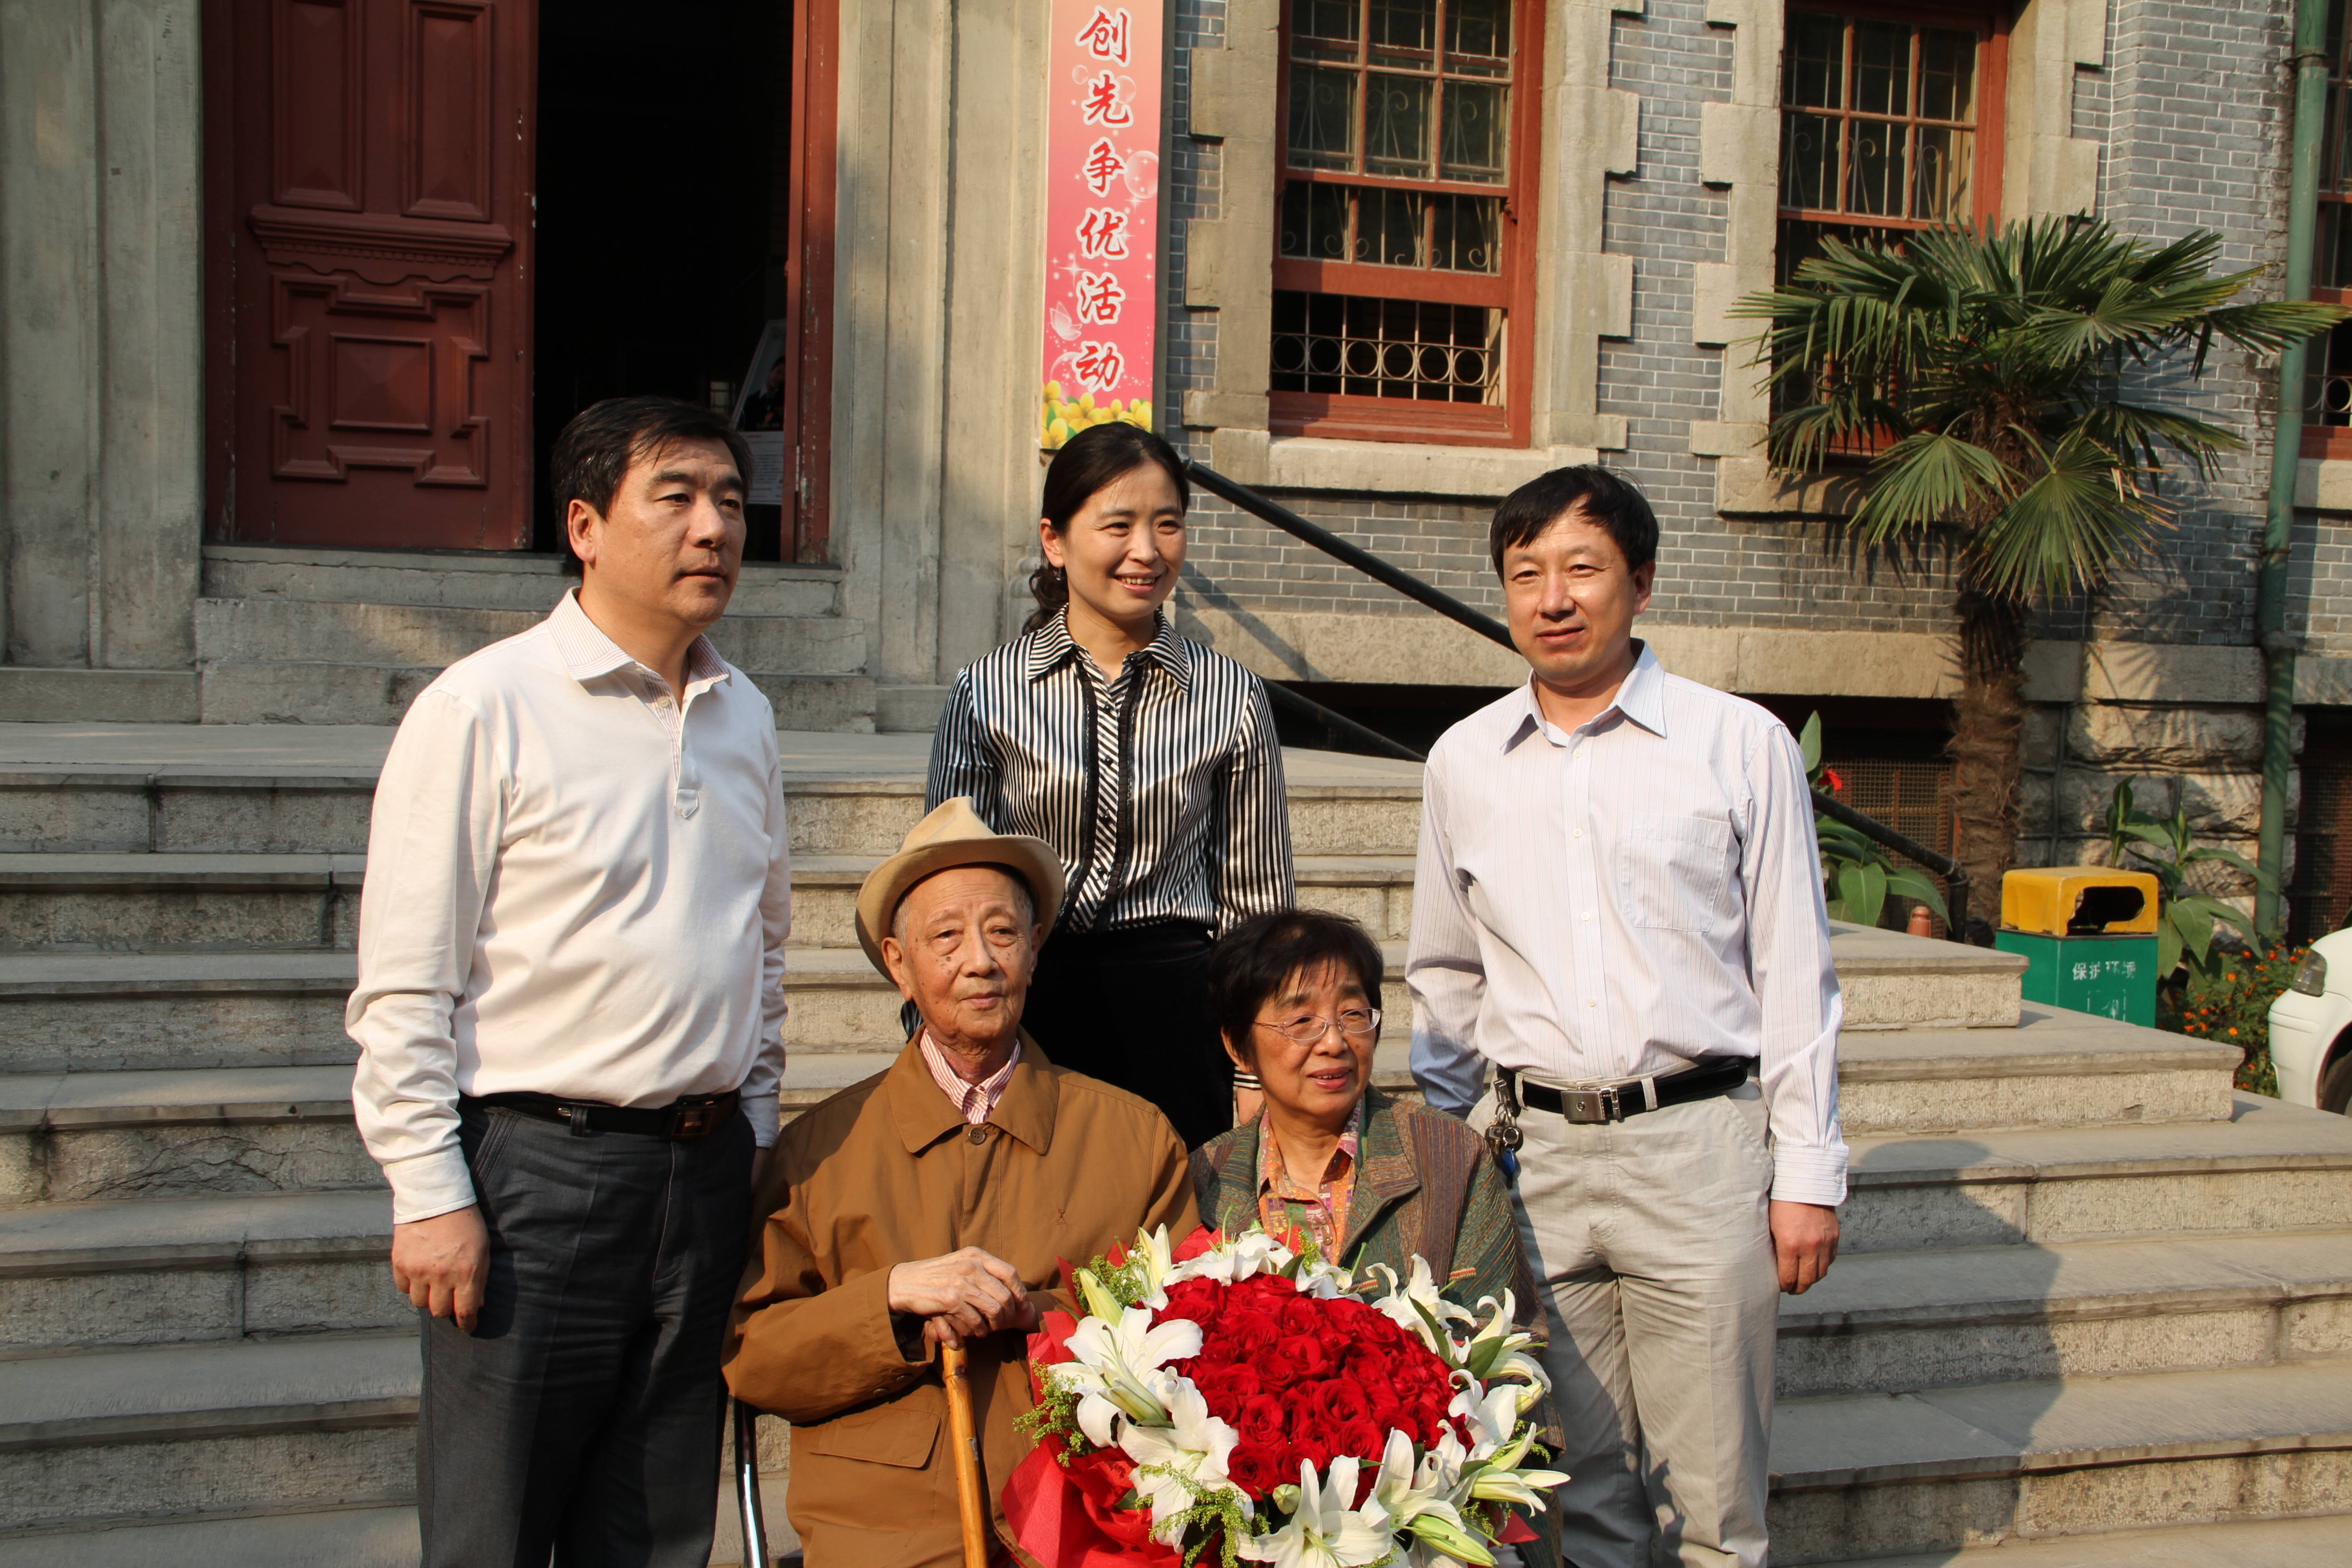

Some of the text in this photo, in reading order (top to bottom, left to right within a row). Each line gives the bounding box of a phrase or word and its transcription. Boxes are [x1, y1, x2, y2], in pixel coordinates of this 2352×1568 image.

[1074, 8, 1132, 392] 创先争优活动
